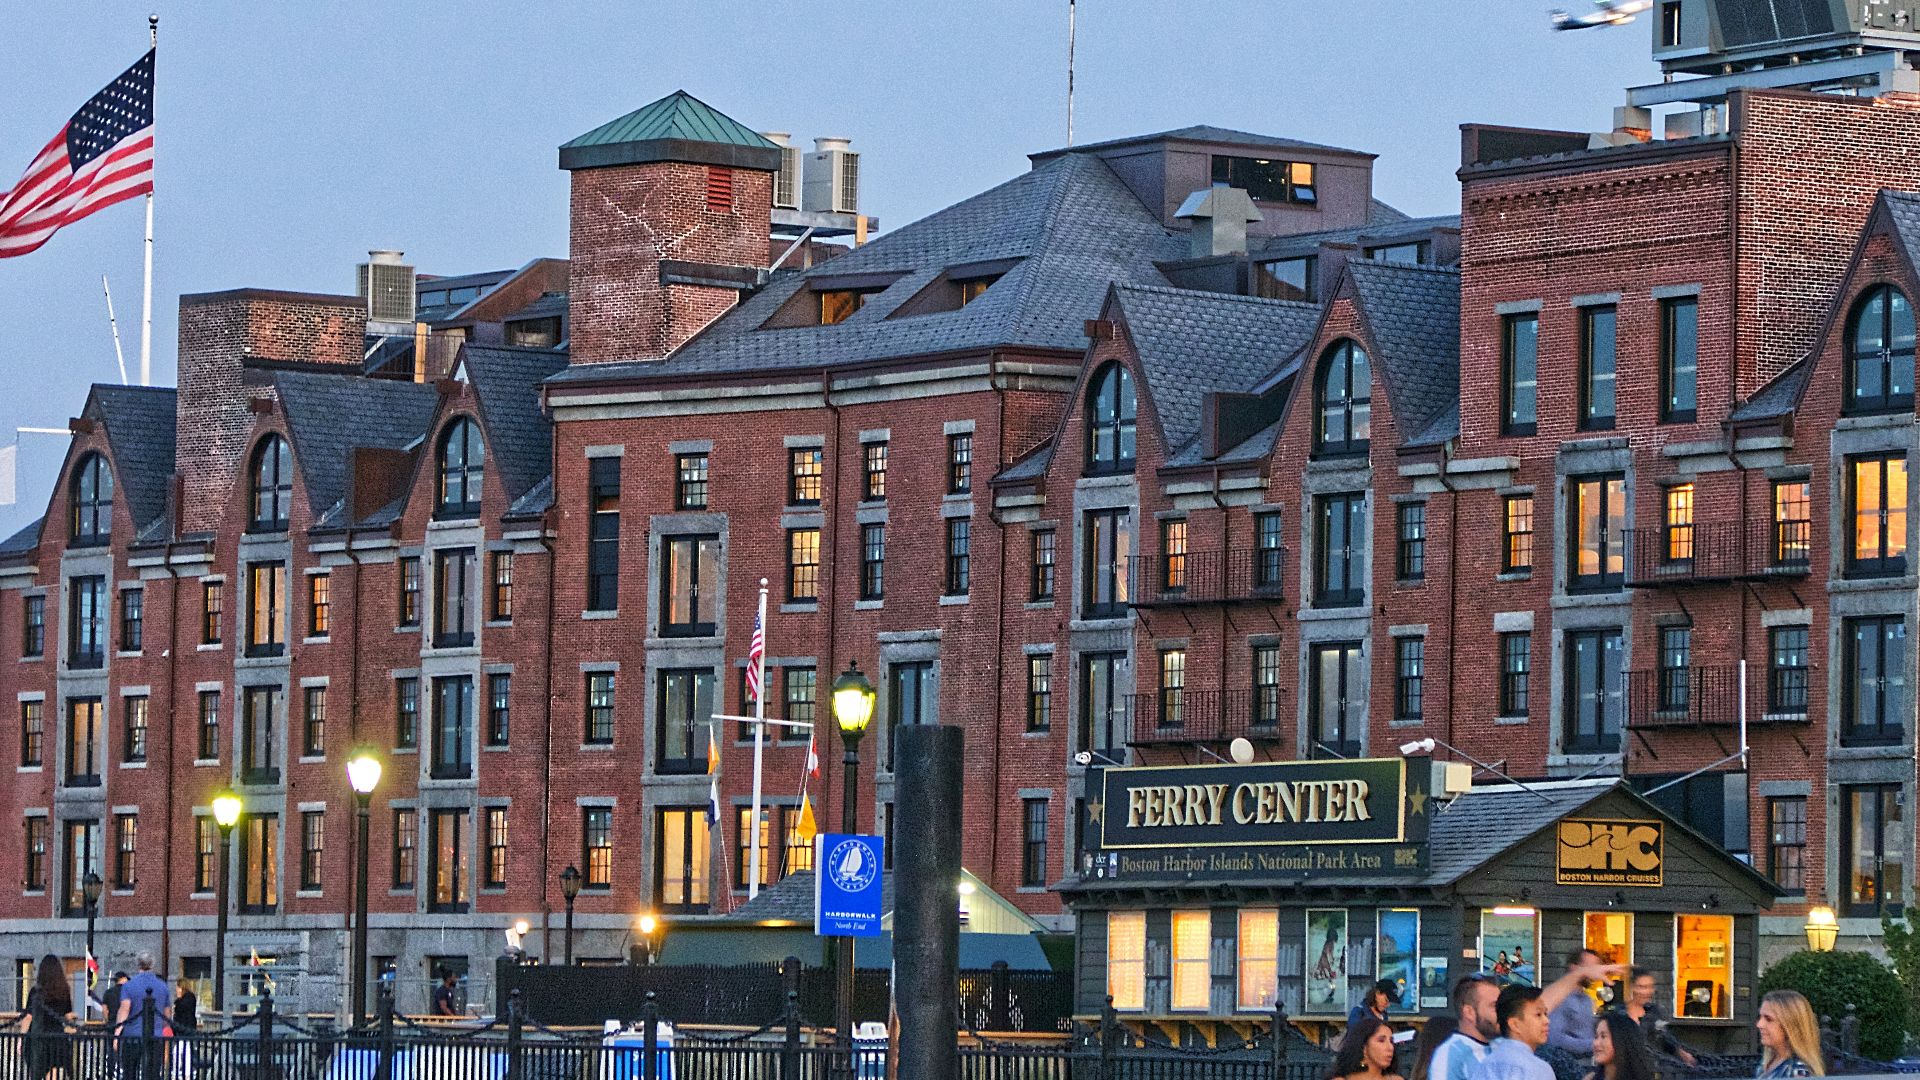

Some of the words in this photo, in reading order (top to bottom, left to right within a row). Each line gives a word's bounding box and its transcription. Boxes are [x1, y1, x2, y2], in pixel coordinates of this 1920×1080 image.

[1126, 784, 1229, 828] FERRY
[1232, 779, 1371, 825] CENTER
[1560, 822, 1660, 871] BHC
[1121, 855, 1160, 873] Boston
[1163, 854, 1206, 872] Harbor
[1210, 852, 1254, 871] Islands
[1258, 851, 1313, 871] National
[1316, 850, 1348, 869] Park
[1352, 852, 1382, 869] Area
[1560, 873, 1592, 881] BOSTON
[1593, 874, 1625, 882] HARBOR
[1626, 874, 1660, 883] CRUISES
[825, 911, 876, 919] HARBORWALK
[853, 922, 867, 930] End
